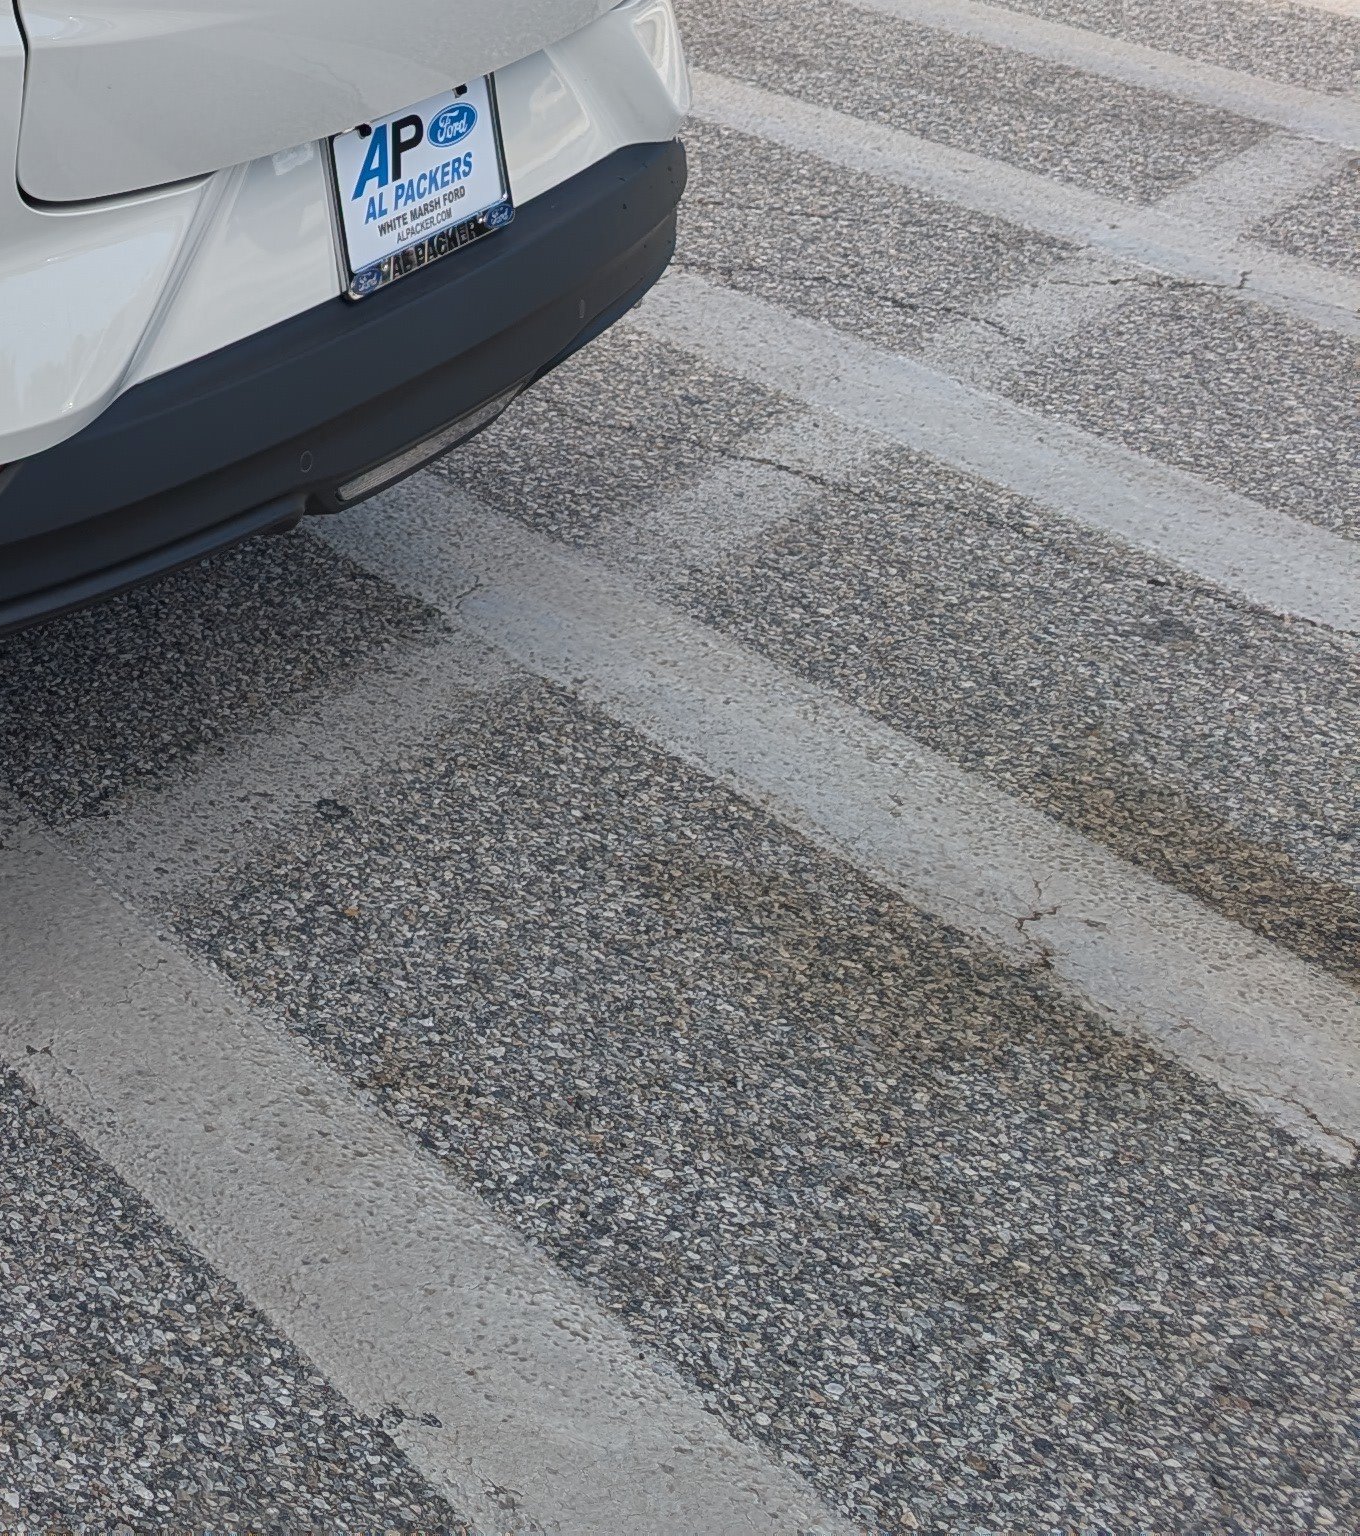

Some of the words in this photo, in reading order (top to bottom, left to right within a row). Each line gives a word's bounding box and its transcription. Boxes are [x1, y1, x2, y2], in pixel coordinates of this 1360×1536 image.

[351, 114, 423, 202] AP
[364, 191, 389, 225] AL
[393, 151, 473, 211] PACKERS
[377, 213, 408, 237] WHITE
[409, 197, 441, 222] MARSH
[443, 185, 466, 207] FORD
[396, 208, 452, 244] ALPACKER.COM
[416, 220, 478, 264] PACKER
